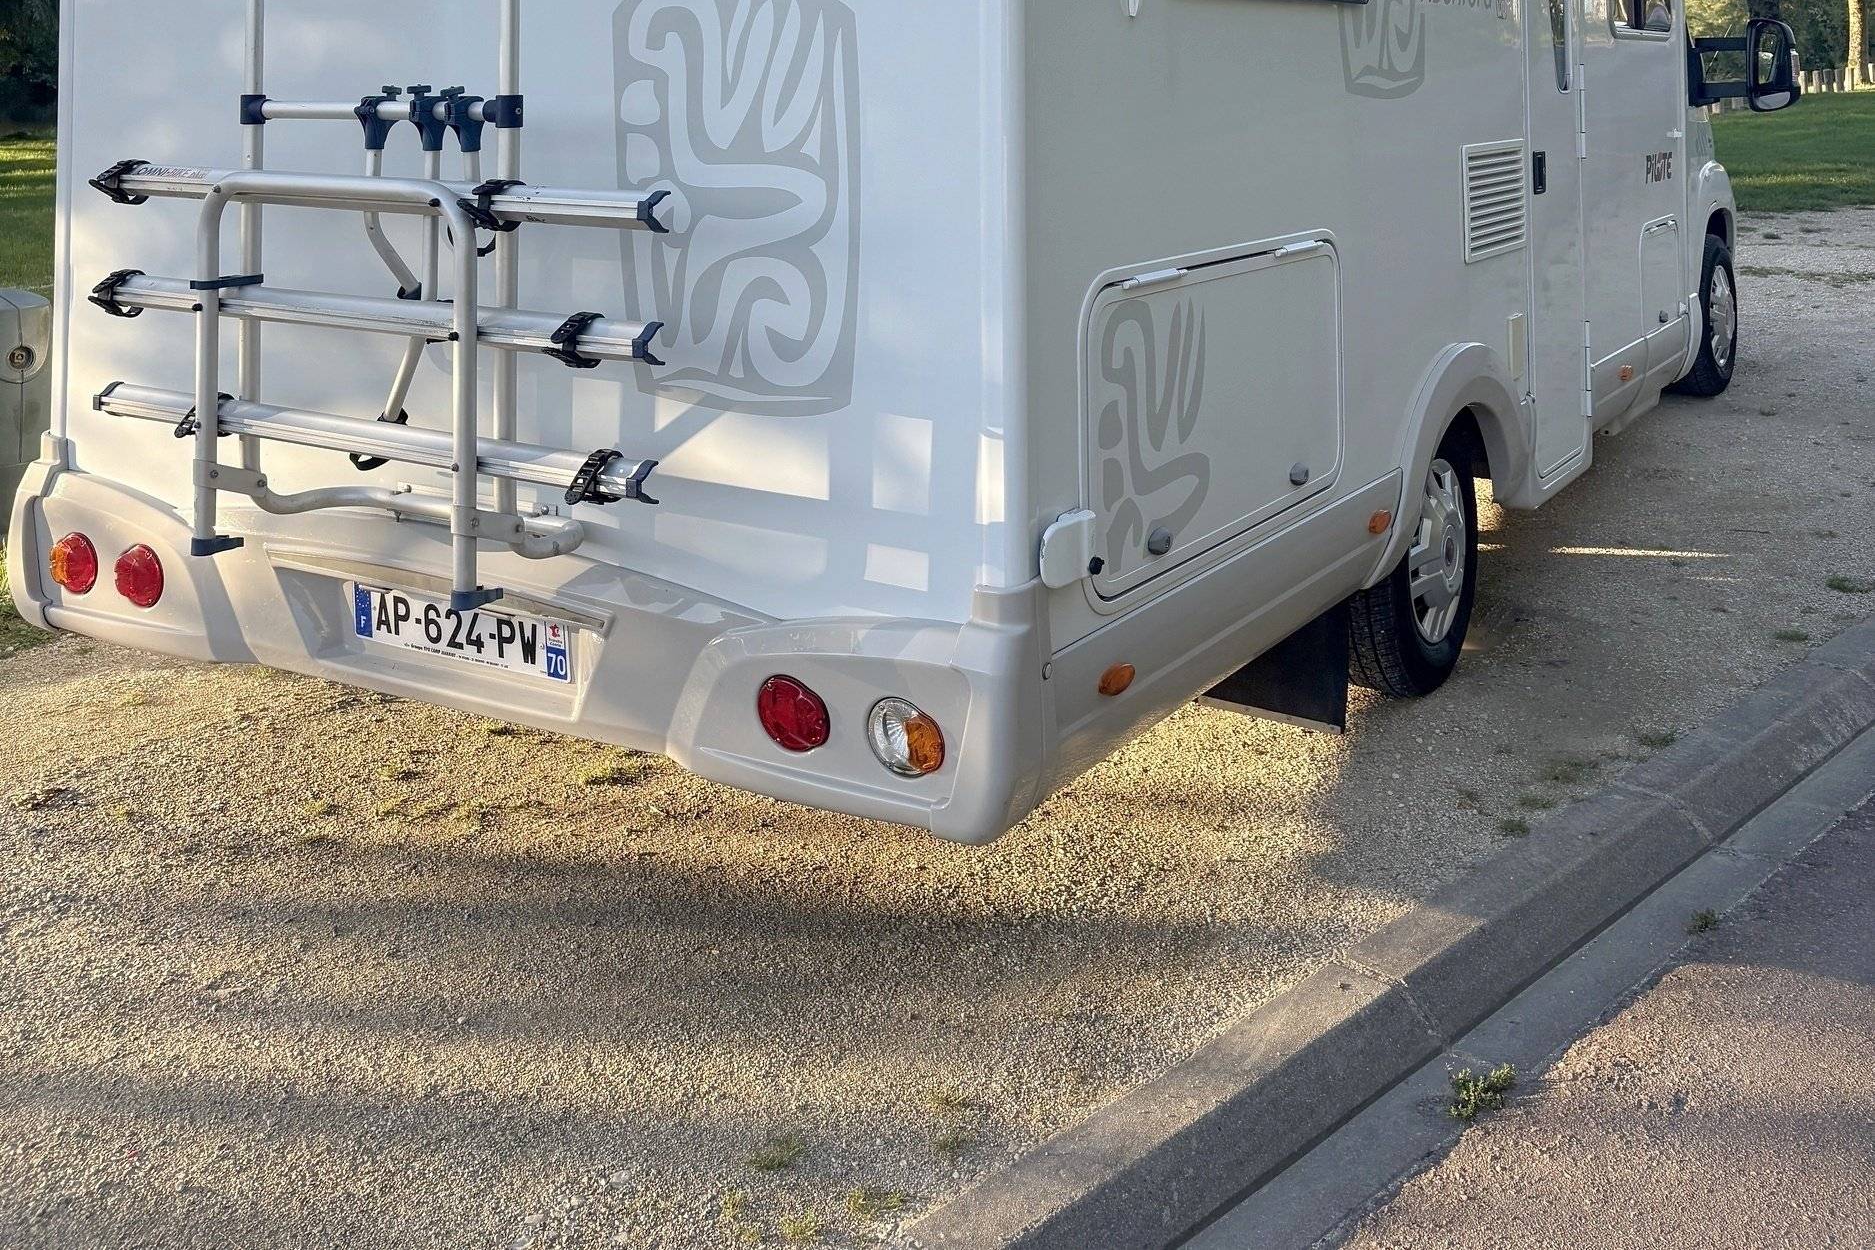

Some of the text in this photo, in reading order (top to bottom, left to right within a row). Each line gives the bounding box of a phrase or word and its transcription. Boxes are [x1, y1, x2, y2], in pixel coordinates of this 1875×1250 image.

[360, 615, 367, 628] F
[376, 593, 537, 665] AP-624-PW
[547, 652, 566, 675] 70
